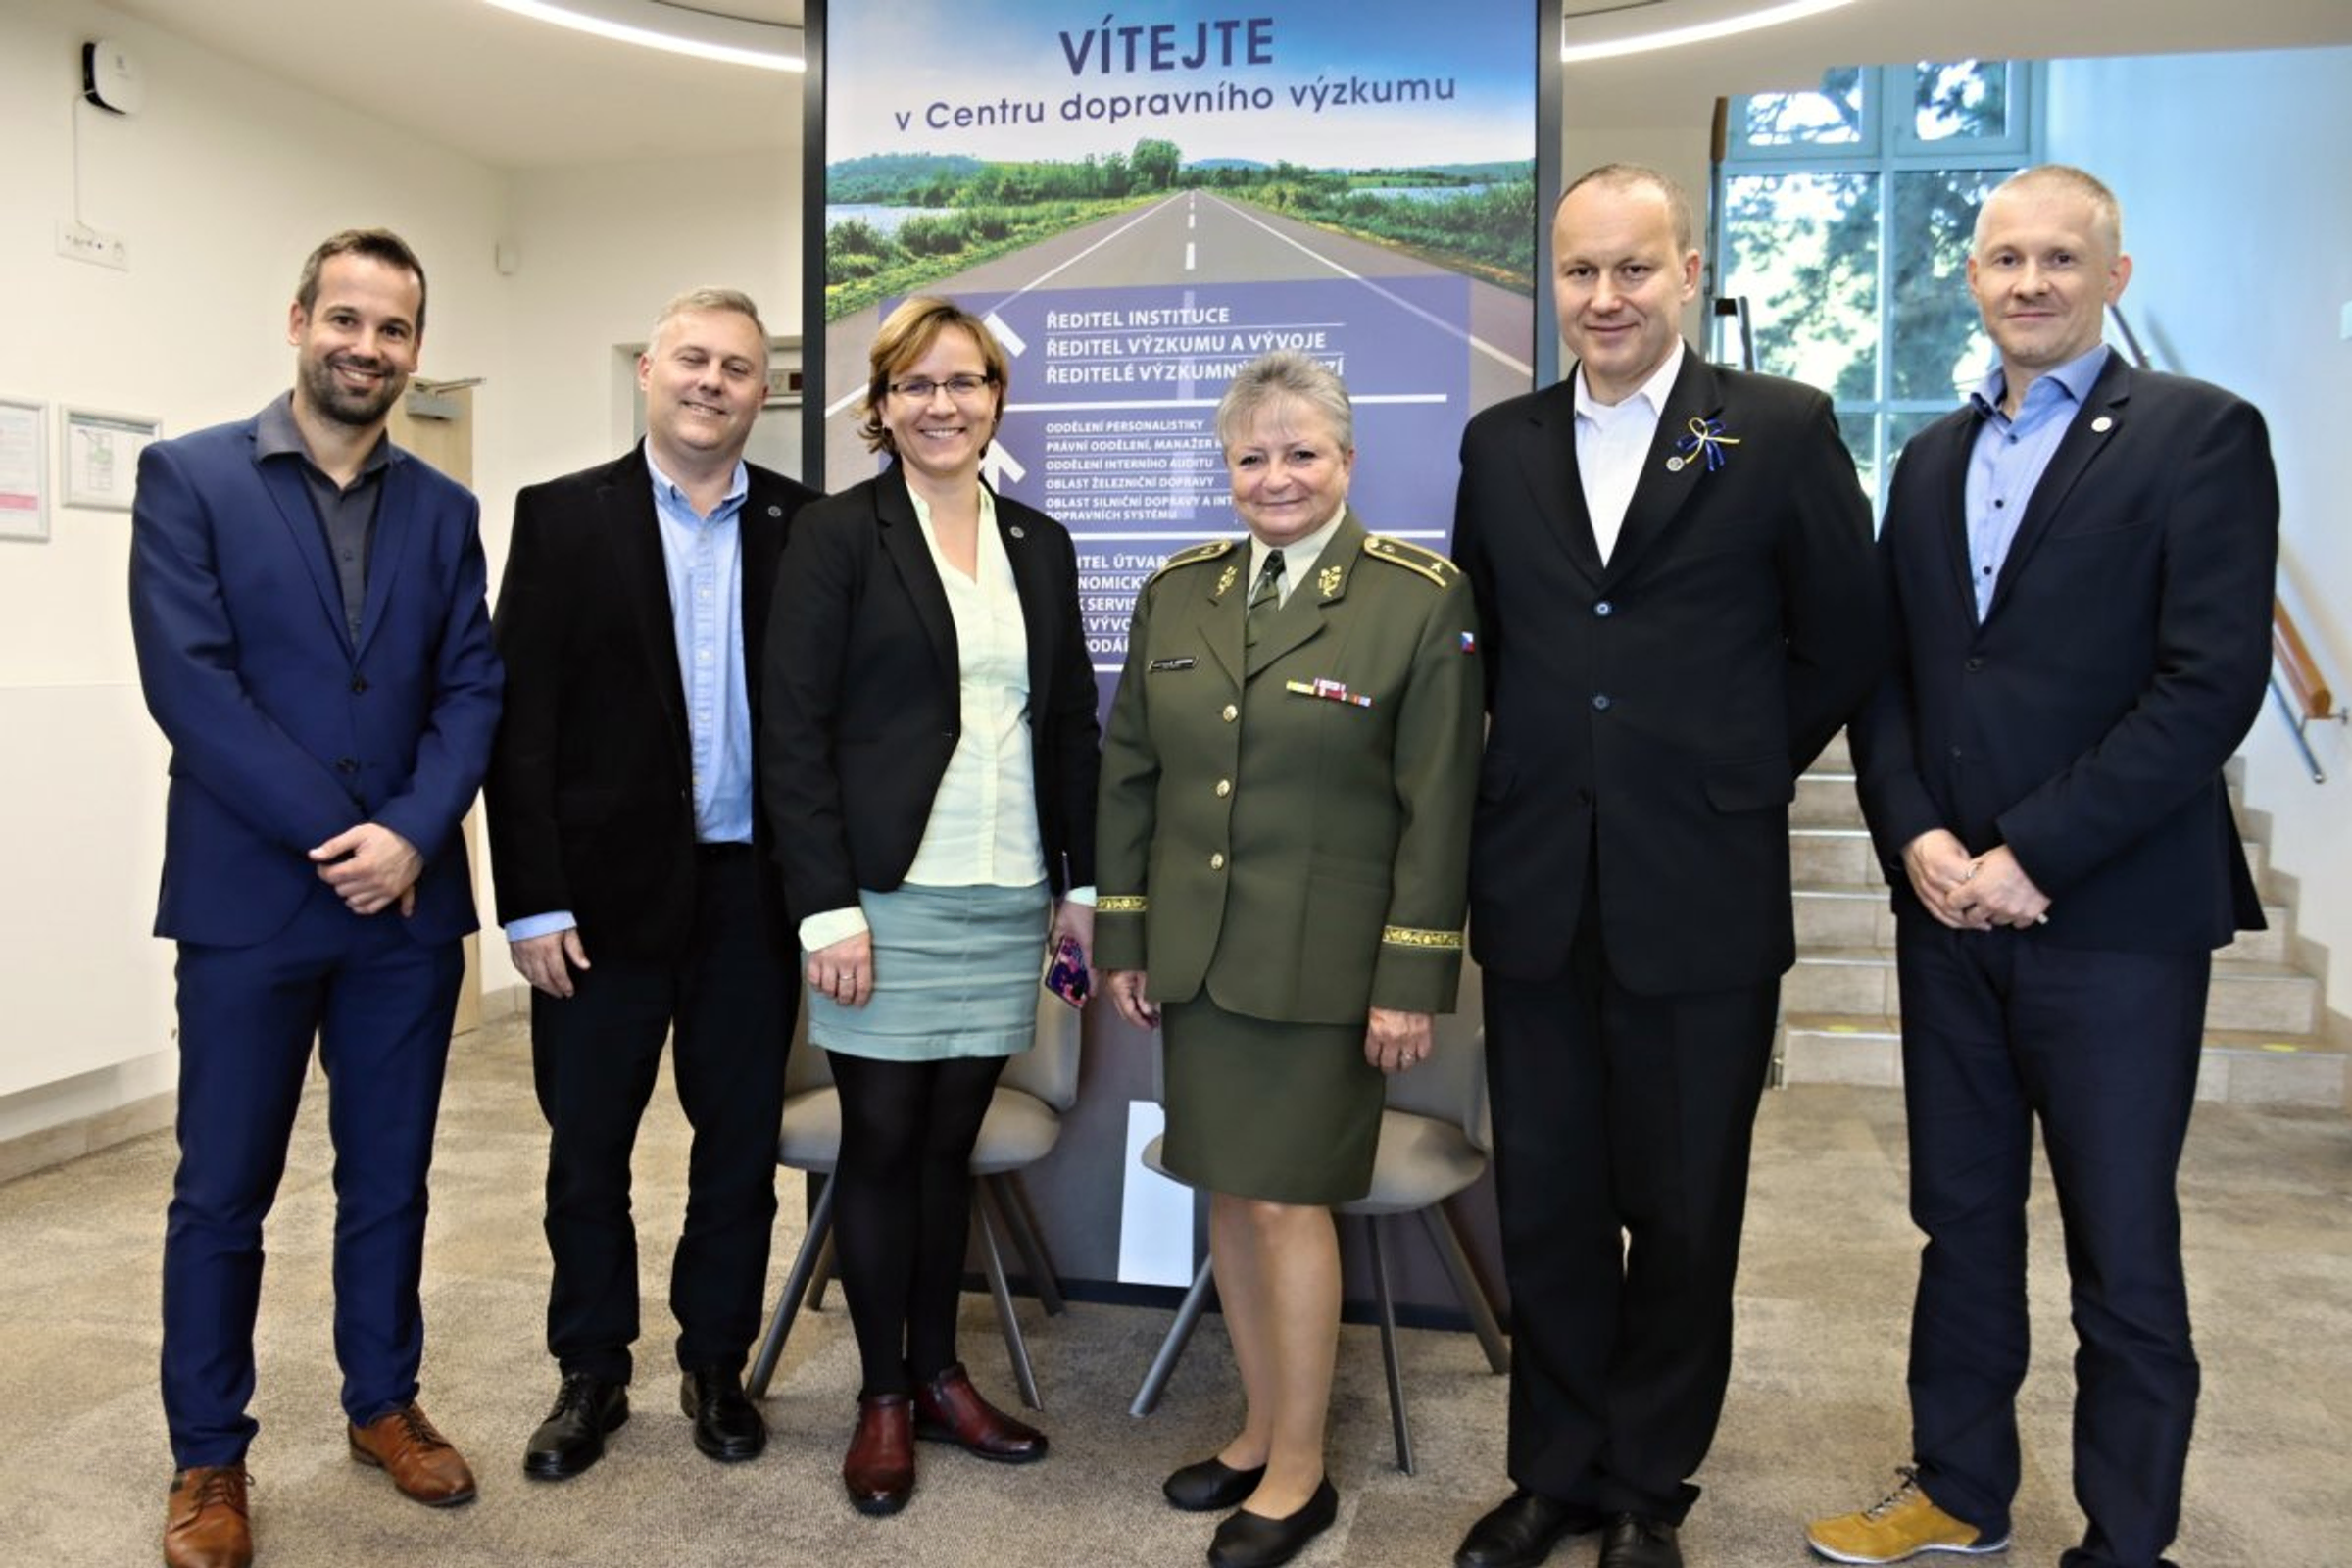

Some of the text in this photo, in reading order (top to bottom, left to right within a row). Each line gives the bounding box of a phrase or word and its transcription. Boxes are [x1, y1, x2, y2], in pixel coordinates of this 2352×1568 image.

[1059, 14, 1274, 75] VÍTEJTE
[895, 75, 1455, 131] v Centru dopravního výzkumu
[1047, 307, 1230, 329] ŘEDITEL INSTITUCE
[1047, 331, 1327, 357] ŘEDITEL VÝZKUMU A VÝVOJE
[1047, 364, 1134, 384] ŘEDITELÉ
[1046, 419, 1204, 433] ODDĚLENÍ PERSONALISTIKY
[1046, 439, 1088, 452] PRÁVNÍ
[1154, 437, 1212, 450] MANAŽER
[1046, 457, 1214, 470] ODDĚLENÍ INTERNÍHO AUDITU
[1046, 476, 1214, 489] OBLAST ŽELEZNIČNÍ DOPRAVY
[1046, 497, 1089, 508] OBLAST
[1092, 495, 1142, 508] SILNIČNÍ
[1144, 496, 1200, 507] DOPRAVY
[1201, 495, 1211, 506] A
[1077, 553, 1168, 569] ITEL ÚTVAR
